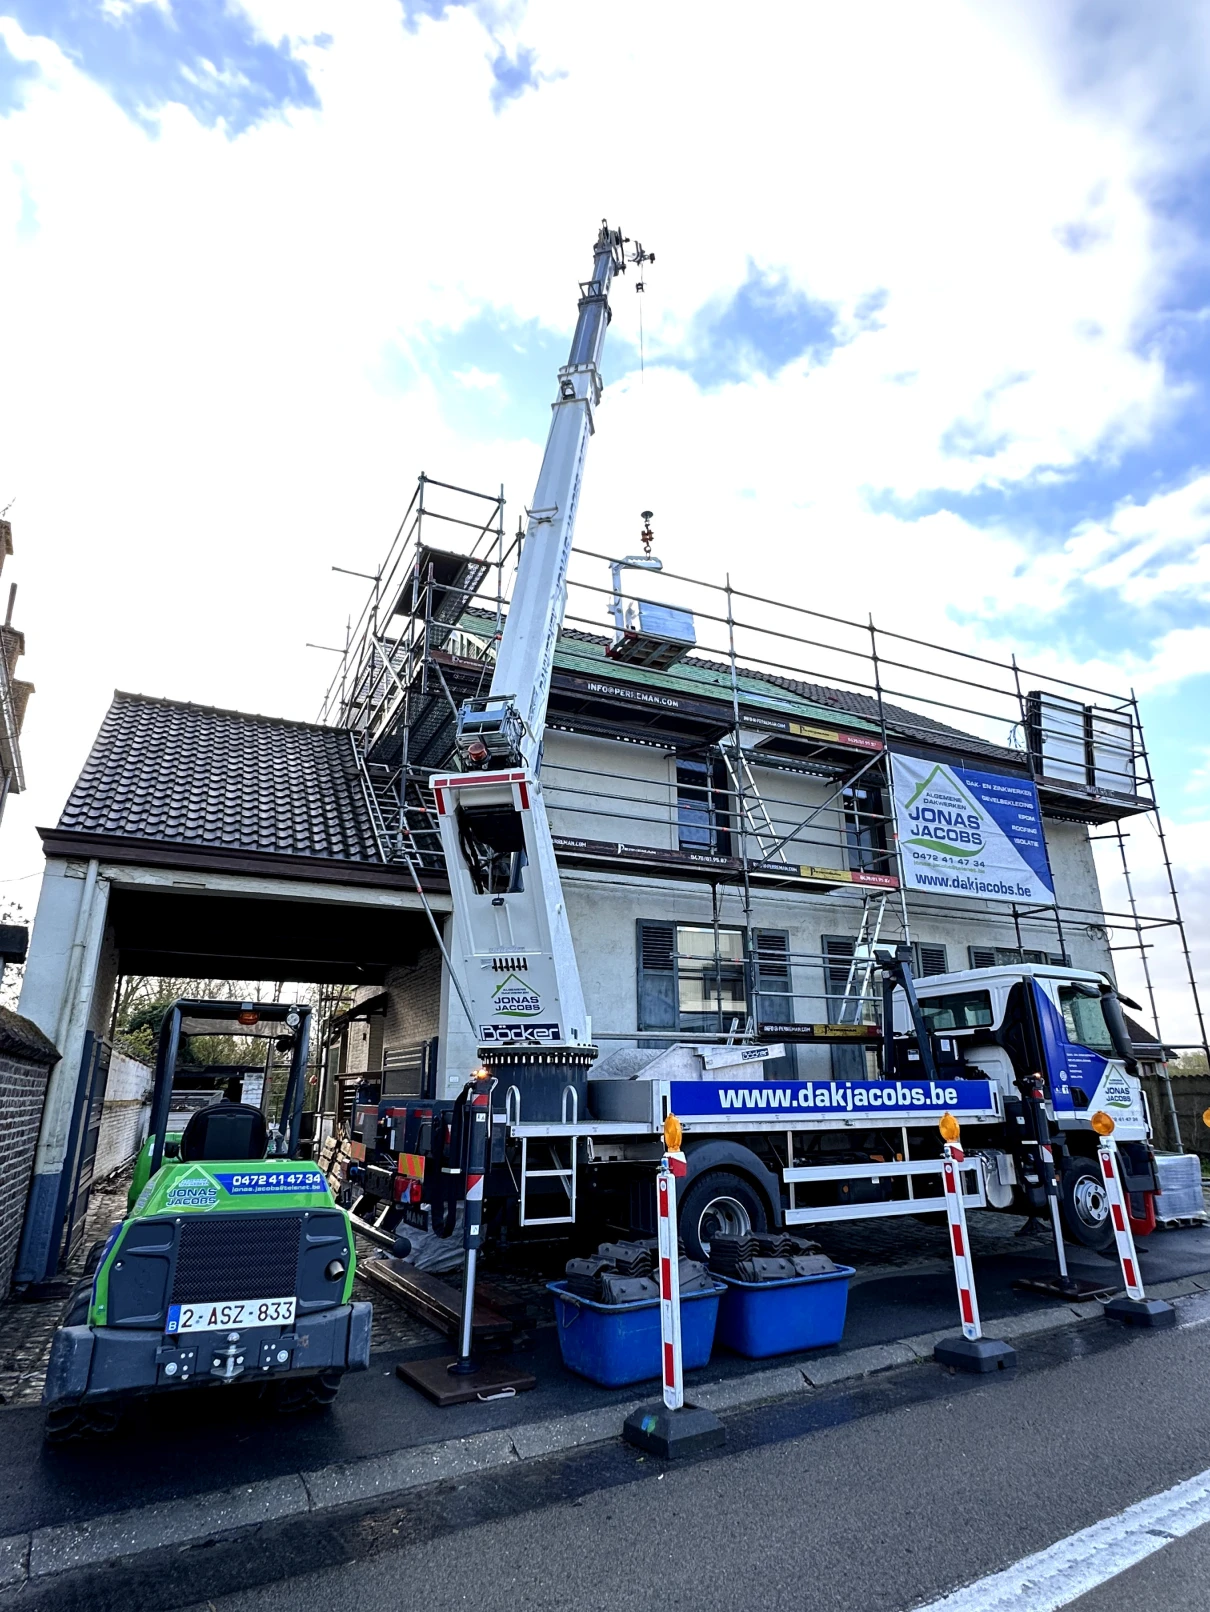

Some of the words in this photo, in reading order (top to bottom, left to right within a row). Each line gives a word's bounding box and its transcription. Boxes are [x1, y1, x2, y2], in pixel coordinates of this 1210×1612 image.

[982, 782, 992, 790] EN
[925, 792, 963, 803] ALGEMENE
[923, 798, 967, 811] DAKWERKEN
[908, 806, 981, 830] JONAS
[910, 823, 983, 846] JACOBS
[912, 851, 939, 862] 0472
[941, 855, 955, 864] 41
[957, 858, 970, 866] 47
[973, 860, 986, 868] 34
[915, 873, 1032, 897] www.dakjacobs.be
[494, 996, 540, 1005] JONAS
[495, 1004, 541, 1012] JACOBS
[480, 1024, 559, 1041] Böcker
[718, 1081, 958, 1111] www.dakjacobs.be
[1105, 1087, 1131, 1095] JONAS
[232, 1175, 267, 1186] 0472
[268, 1174, 285, 1185] 41
[287, 1174, 304, 1184] 47
[305, 1173, 321, 1184] 34
[168, 1188, 217, 1198] JONAS
[231, 1184, 321, 1193] jonas.jacobs@telenet.be
[167, 1197, 216, 1206] JACOBS
[406, 1209, 424, 1226] MAN
[168, 1321, 177, 1331] B
